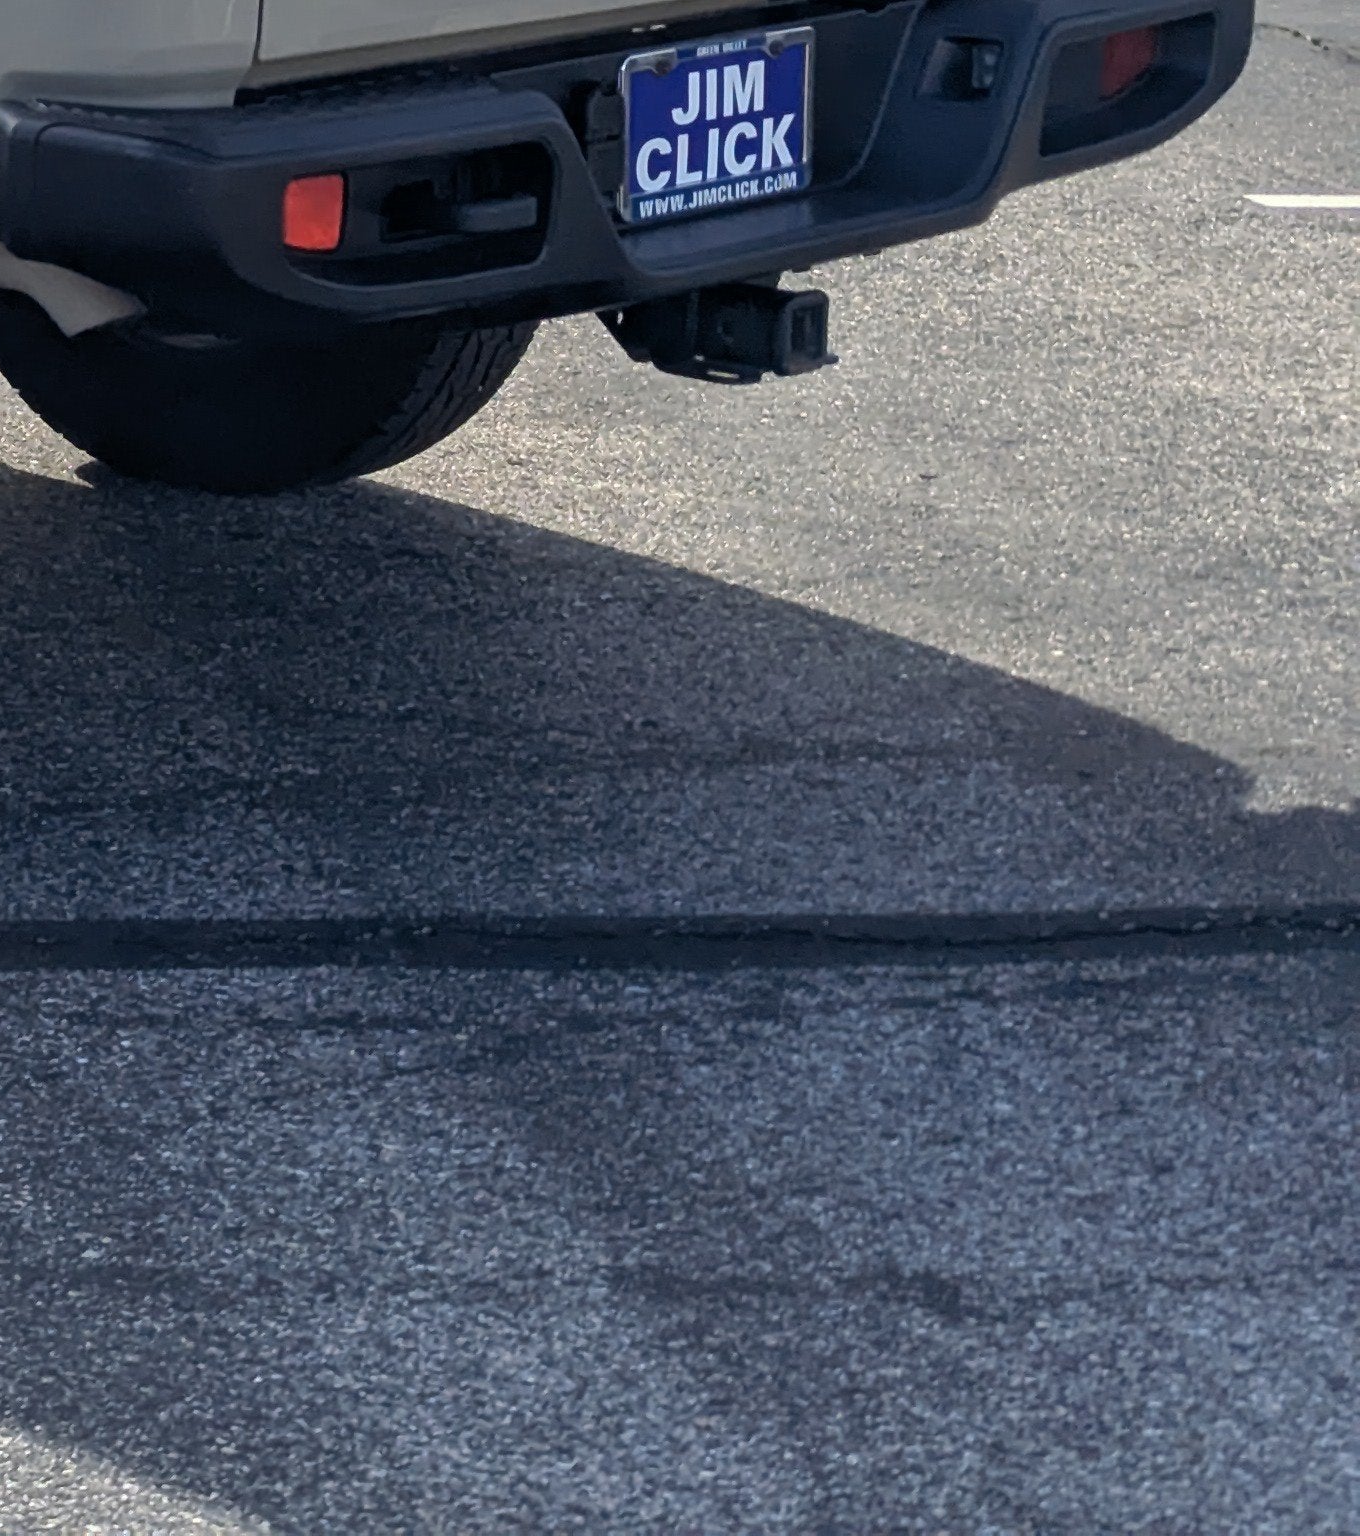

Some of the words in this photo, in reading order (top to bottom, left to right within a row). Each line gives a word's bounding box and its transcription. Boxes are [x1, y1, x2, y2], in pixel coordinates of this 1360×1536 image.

[671, 60, 765, 125] JIM
[636, 113, 795, 193] CLICK
[639, 171, 797, 219] WWW.JIMCLICK.COM
